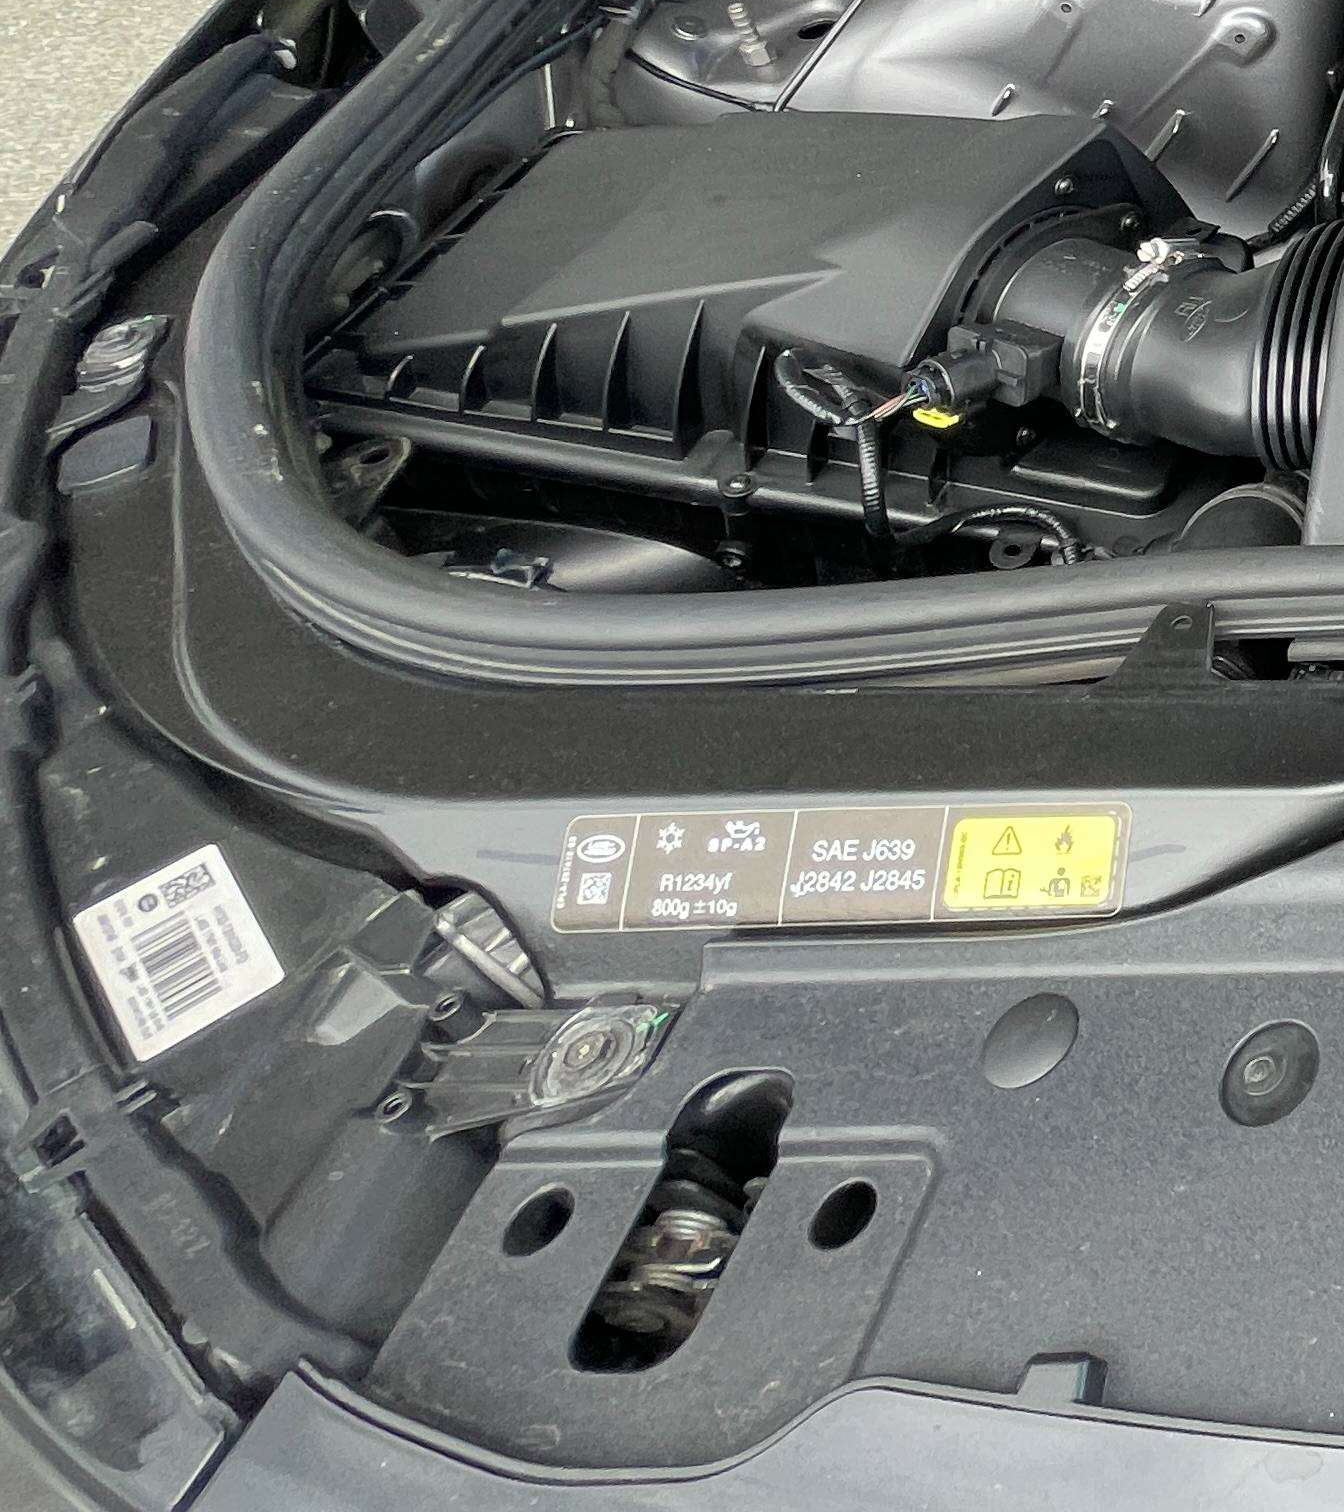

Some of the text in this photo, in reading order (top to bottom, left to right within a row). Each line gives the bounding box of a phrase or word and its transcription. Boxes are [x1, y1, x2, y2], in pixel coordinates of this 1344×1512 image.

[811, 838, 917, 862] SAE J639
[790, 869, 927, 896] J2842 J2845
[651, 898, 691, 920] 800g
